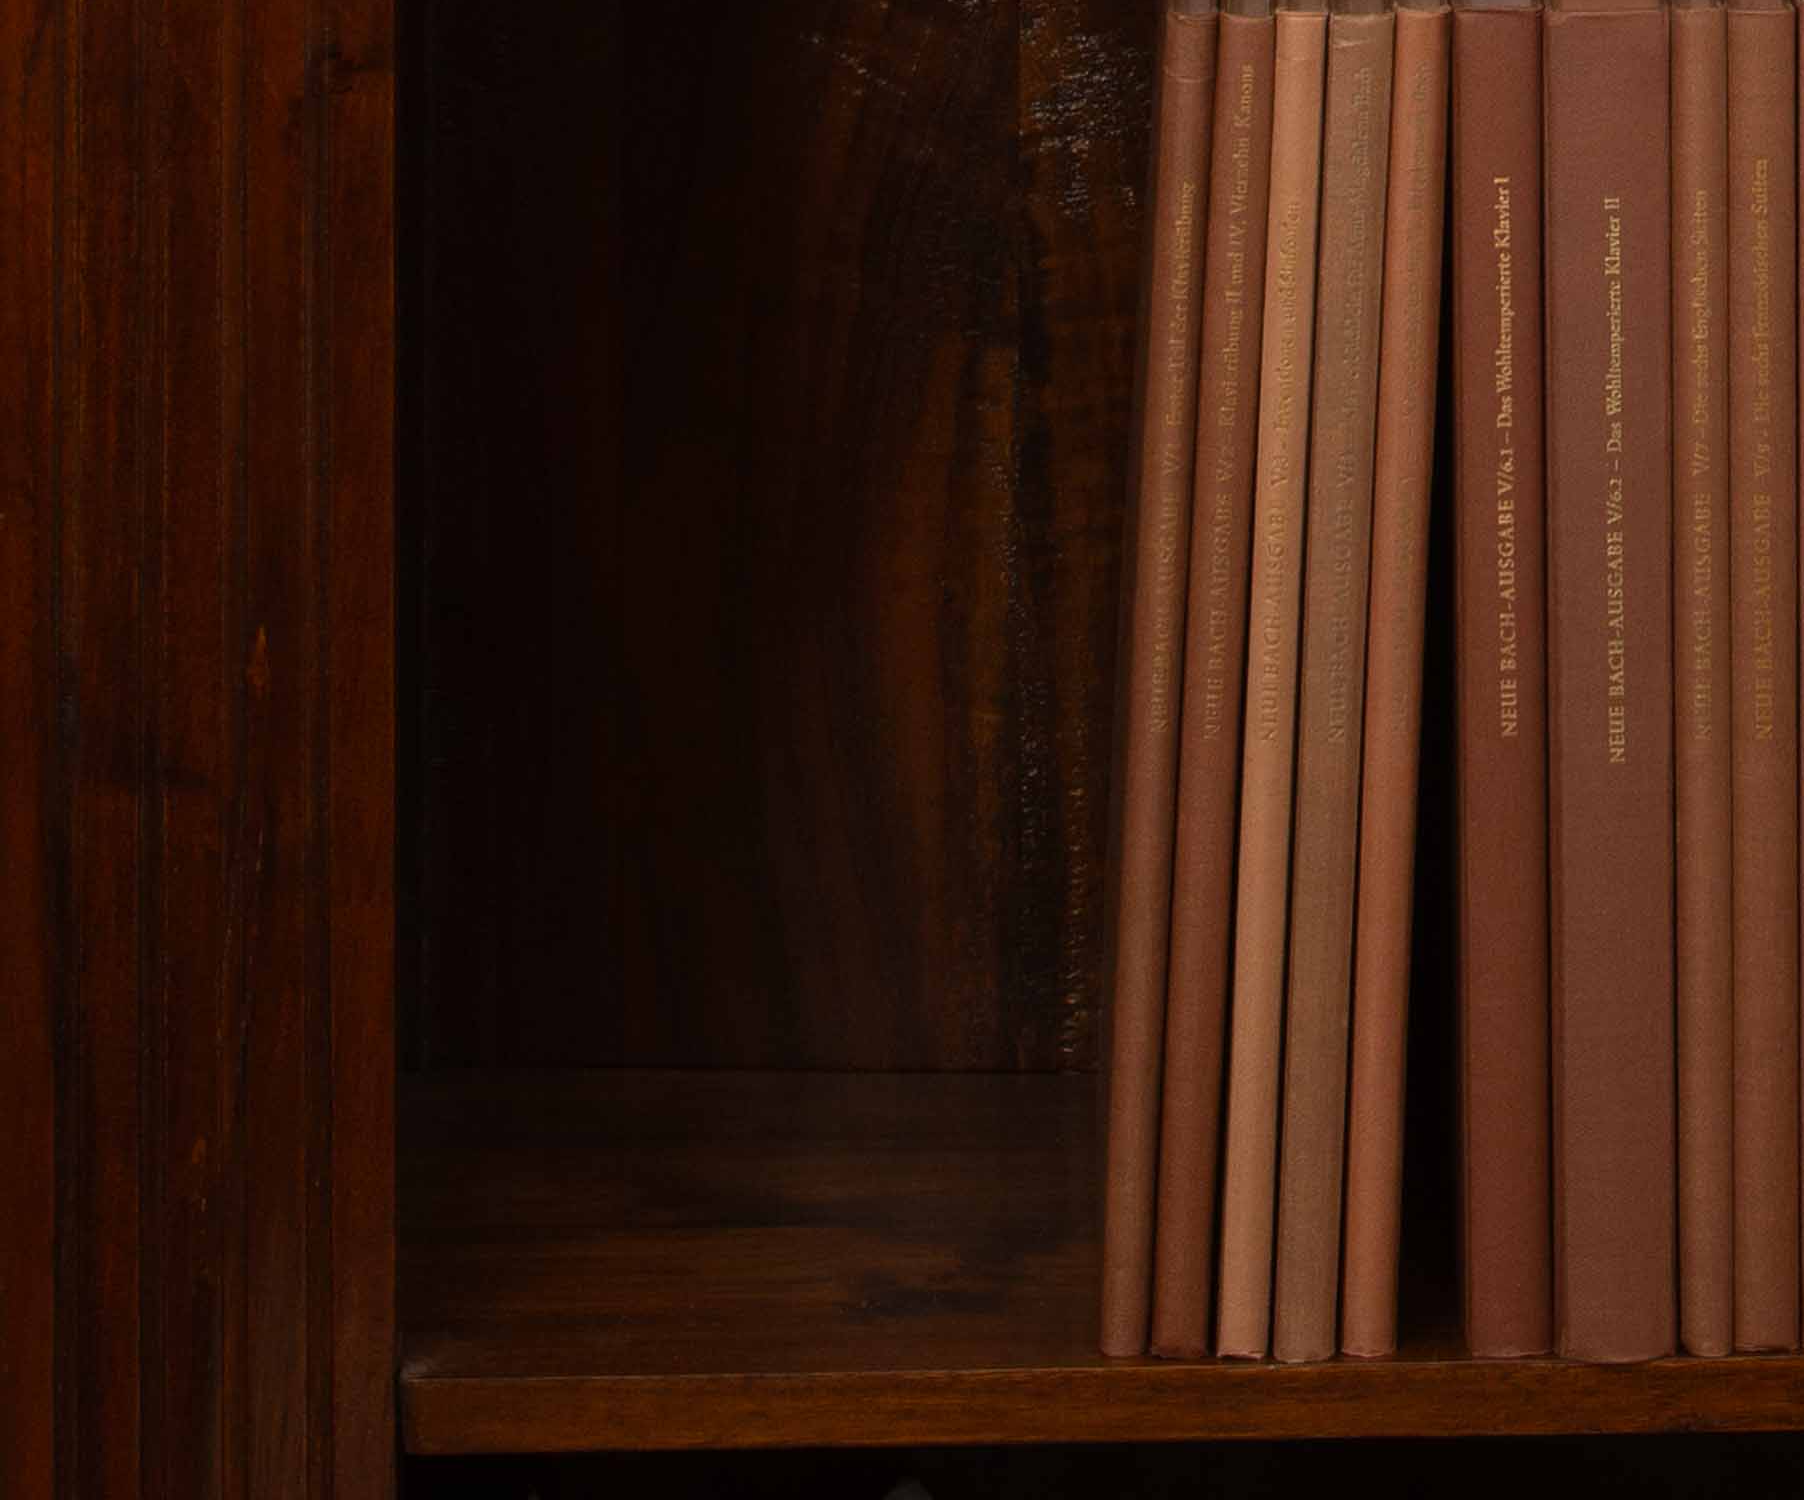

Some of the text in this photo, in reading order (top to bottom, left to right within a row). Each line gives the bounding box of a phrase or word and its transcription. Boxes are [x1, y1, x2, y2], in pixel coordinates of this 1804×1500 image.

[1492, 175, 1517, 736] NEUE BACH-AUSGABE V/6.1 Das Wohltemperierte Klavier I
